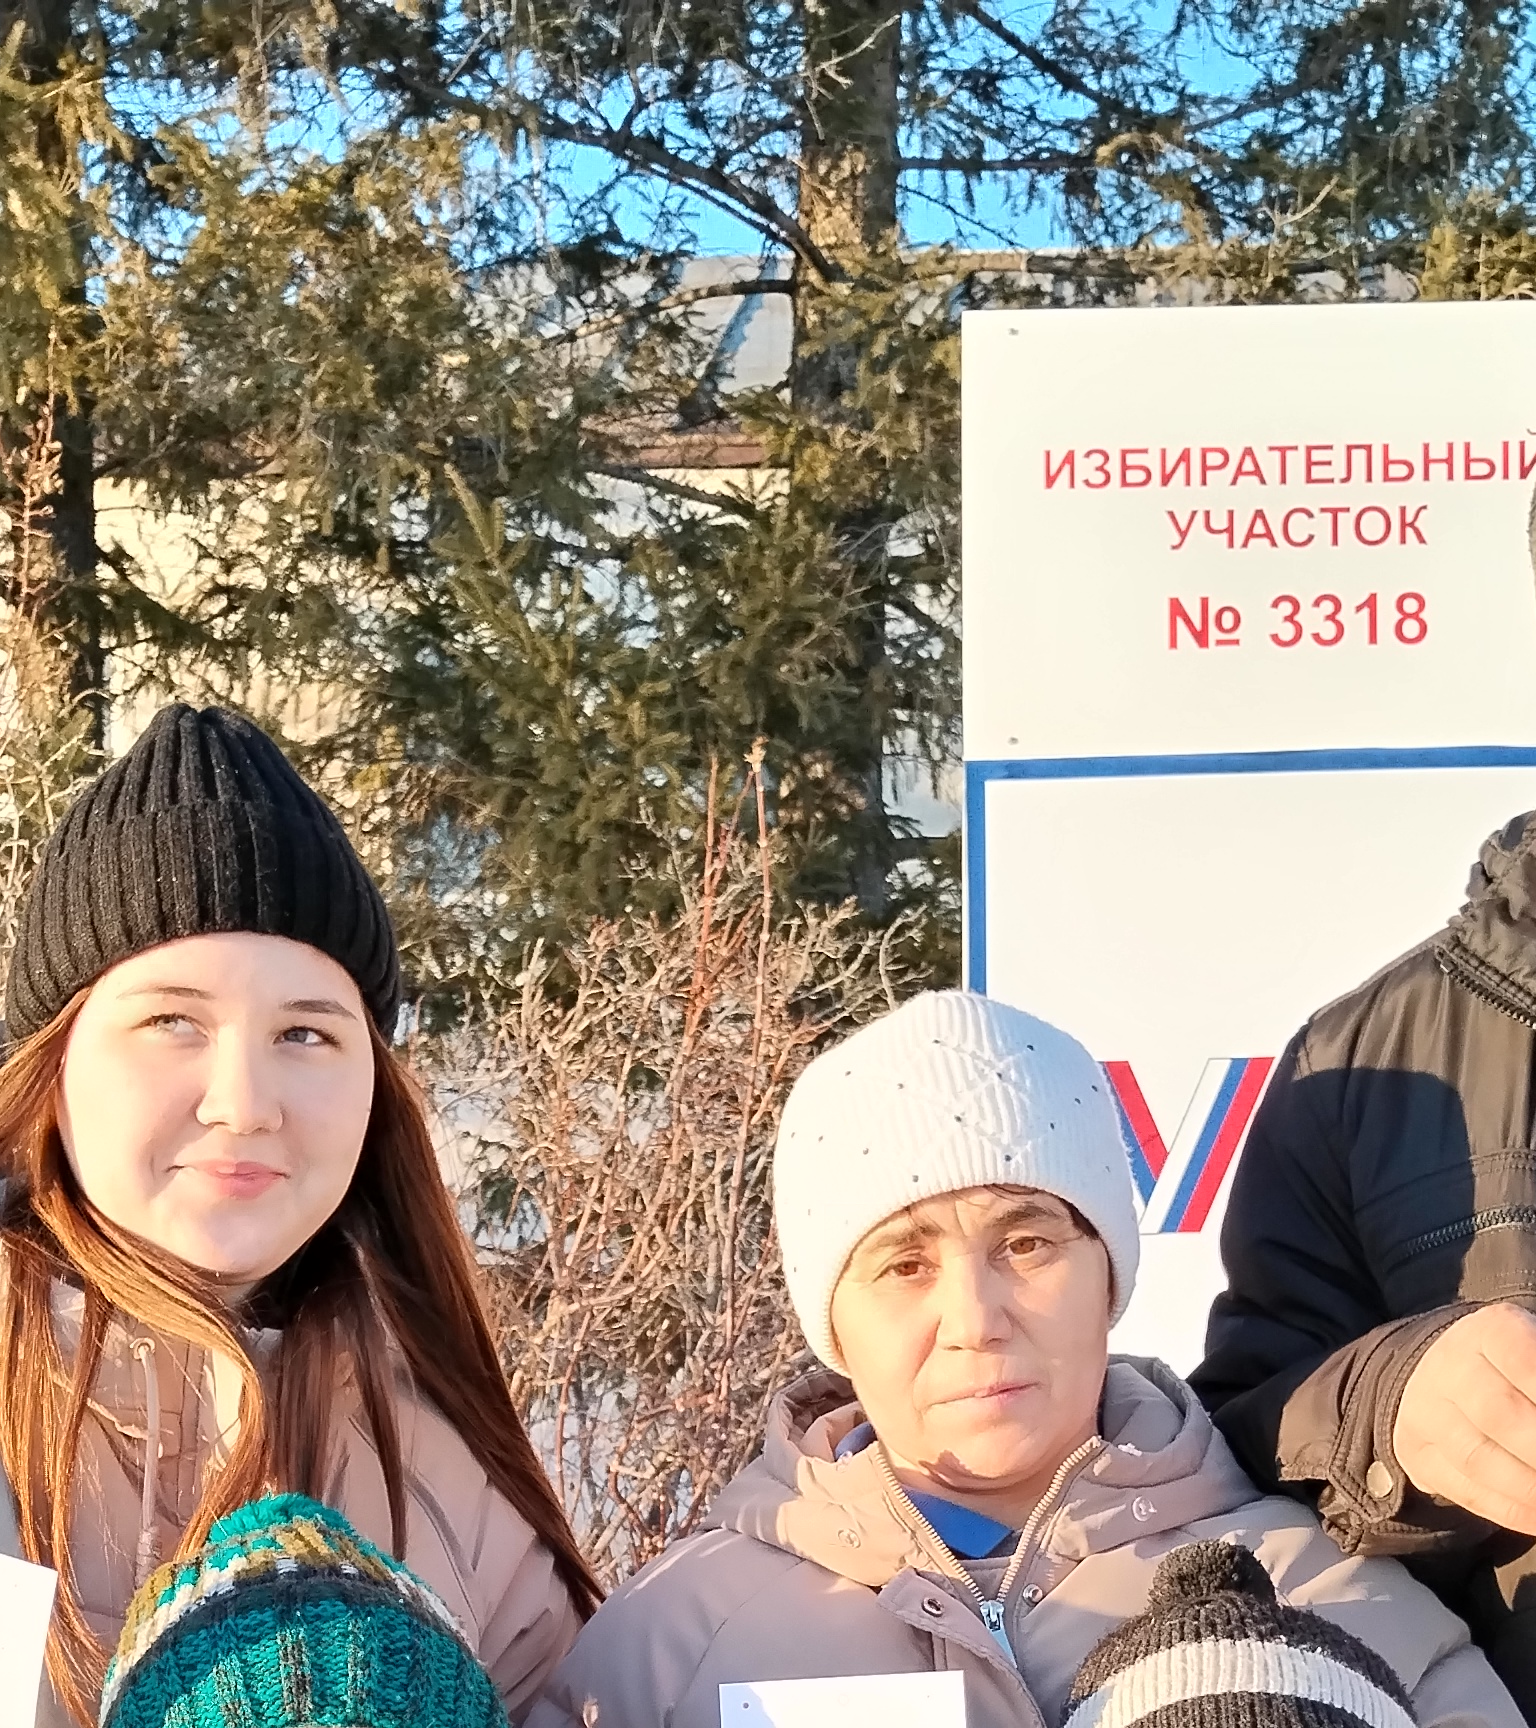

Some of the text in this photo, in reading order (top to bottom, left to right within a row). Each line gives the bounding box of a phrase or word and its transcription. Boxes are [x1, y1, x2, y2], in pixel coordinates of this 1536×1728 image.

[1168, 505, 1428, 551] УЧАСТОК
[1167, 592, 1429, 650] № 3318
